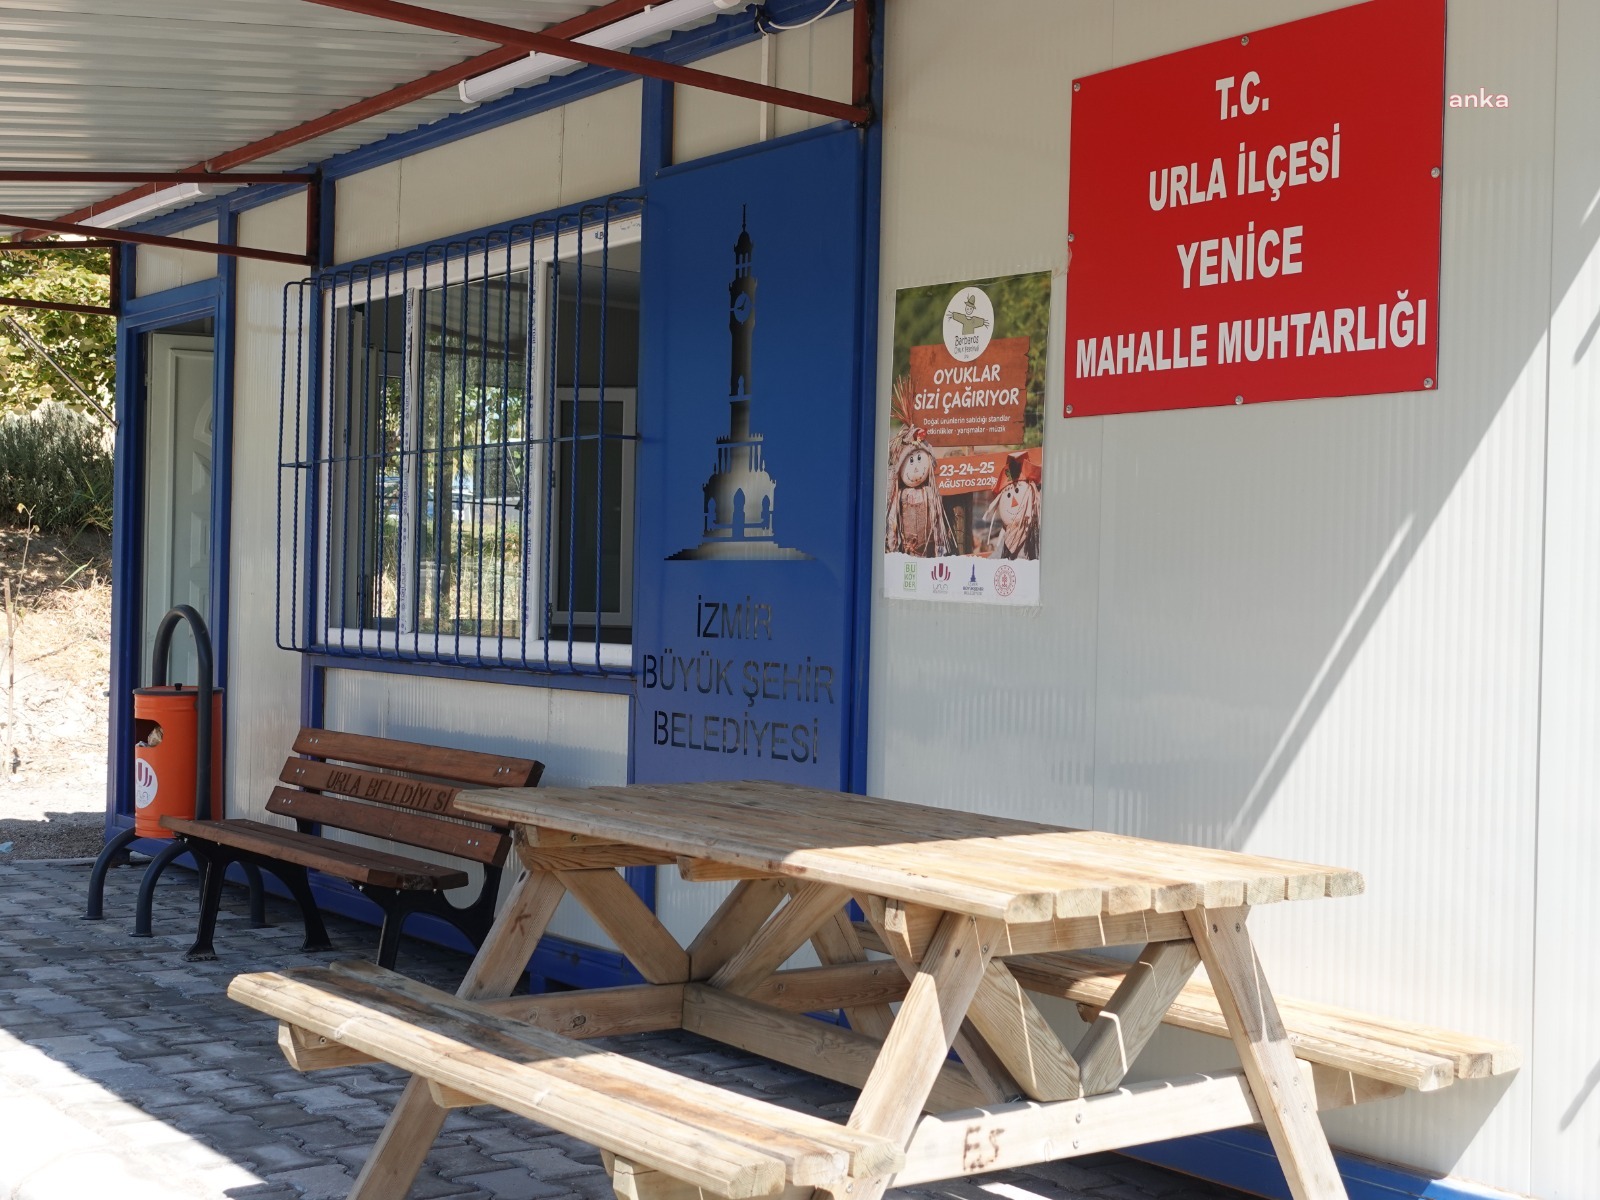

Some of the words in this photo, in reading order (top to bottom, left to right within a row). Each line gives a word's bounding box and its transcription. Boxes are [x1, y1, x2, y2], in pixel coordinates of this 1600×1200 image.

[1215, 71, 1270, 121] T.C.
[1149, 157, 1228, 212] URLA
[1237, 122, 1342, 202] İLÇESİ
[1176, 221, 1304, 290] YENİCE
[1075, 324, 1208, 380] MAHALLE
[1217, 289, 1428, 366] MUHTARLIĞI
[933, 363, 1001, 385] OYUKLAR
[914, 388, 941, 411] SİZİ
[943, 386, 1020, 414] ÇAĞIRIYOR
[938, 477, 976, 489] AĞUSTOS
[939, 461, 995, 477] 23-24-25
[696, 594, 773, 641] İZMİR
[642, 648, 734, 696] BÜYÜK
[742, 656, 835, 708] ŞEHİR
[653, 710, 819, 765] BELEDİYESİ
[325, 769, 363, 795] URLA
